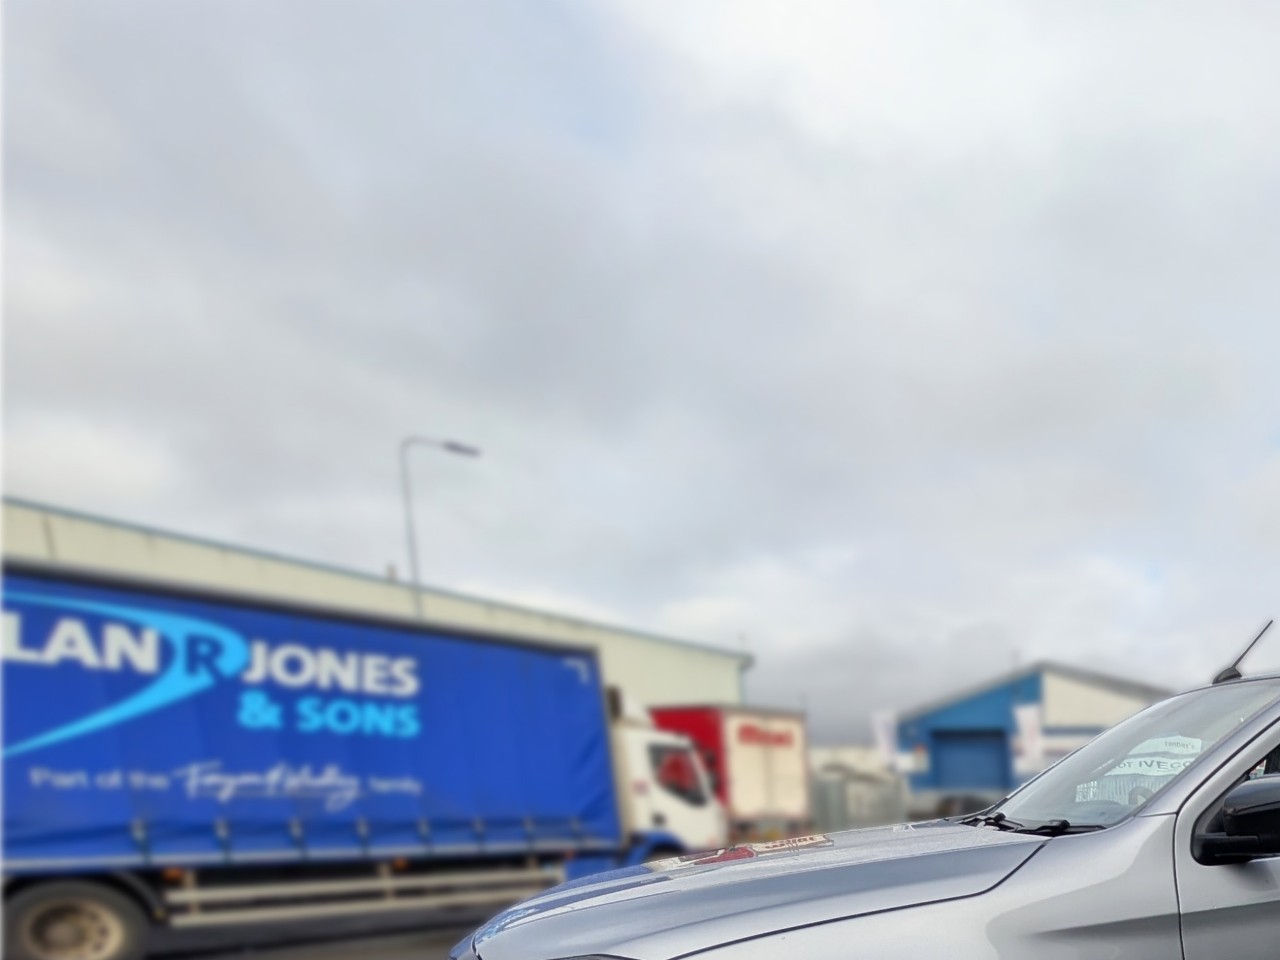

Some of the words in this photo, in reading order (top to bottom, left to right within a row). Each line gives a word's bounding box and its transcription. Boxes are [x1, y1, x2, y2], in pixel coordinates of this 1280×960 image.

[184, 632, 234, 678] R
[243, 641, 421, 697] JONES
[237, 690, 282, 729] &
[297, 697, 421, 737] SONS
